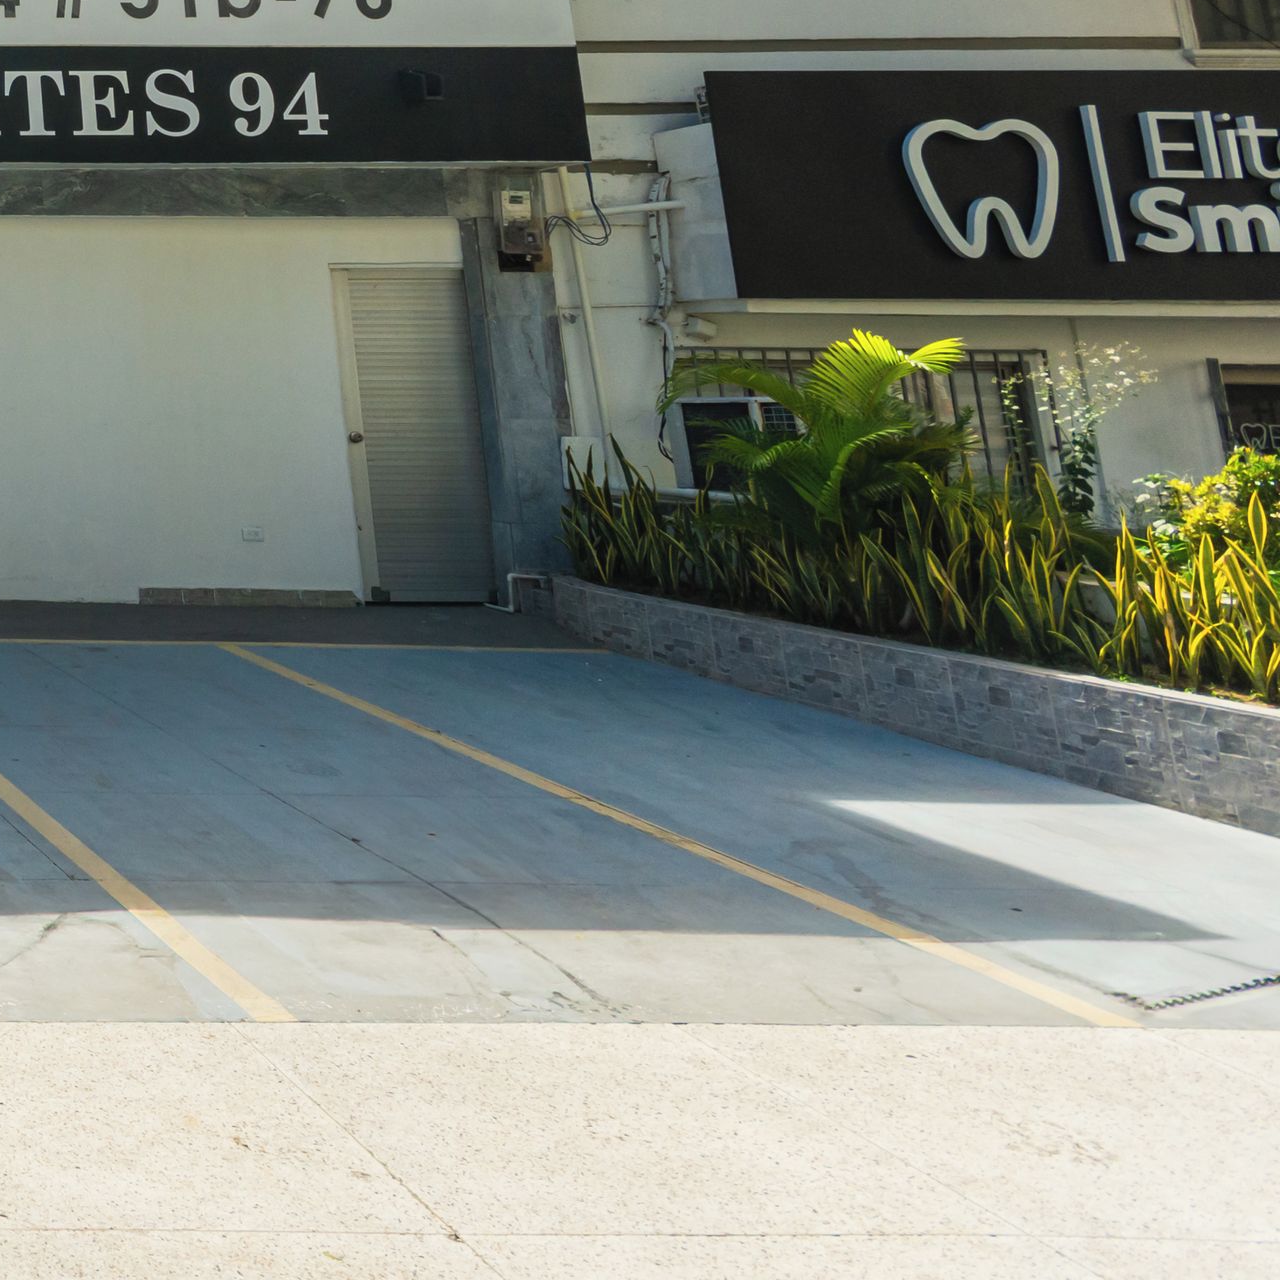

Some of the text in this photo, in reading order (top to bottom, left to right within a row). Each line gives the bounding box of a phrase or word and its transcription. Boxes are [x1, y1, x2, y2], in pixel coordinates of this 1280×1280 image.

[229, 71, 329, 137] 94
[1138, 110, 1280, 179] Elit
[1129, 182, 1280, 253] Sm
